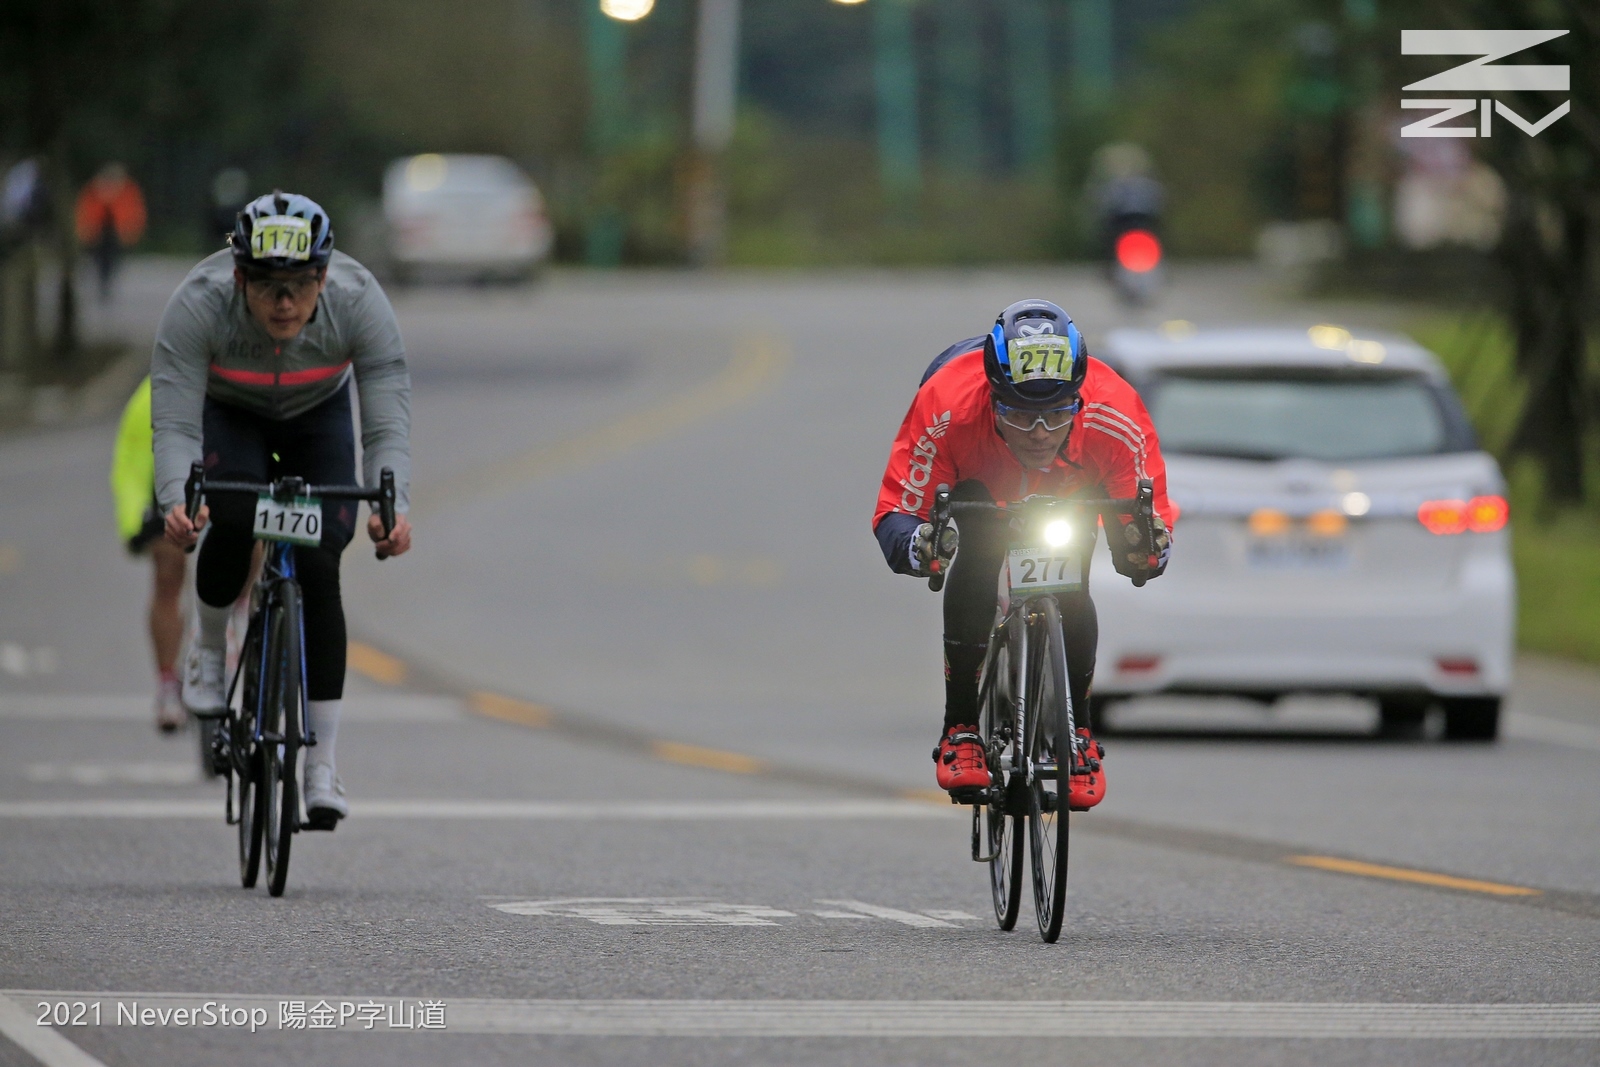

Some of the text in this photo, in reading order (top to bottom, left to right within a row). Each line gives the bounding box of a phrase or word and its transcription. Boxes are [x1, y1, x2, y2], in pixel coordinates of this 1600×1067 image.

[256, 230, 308, 253] 1170
[1020, 350, 1065, 374] 277
[259, 509, 319, 535] 1170
[1020, 556, 1072, 584] 277
